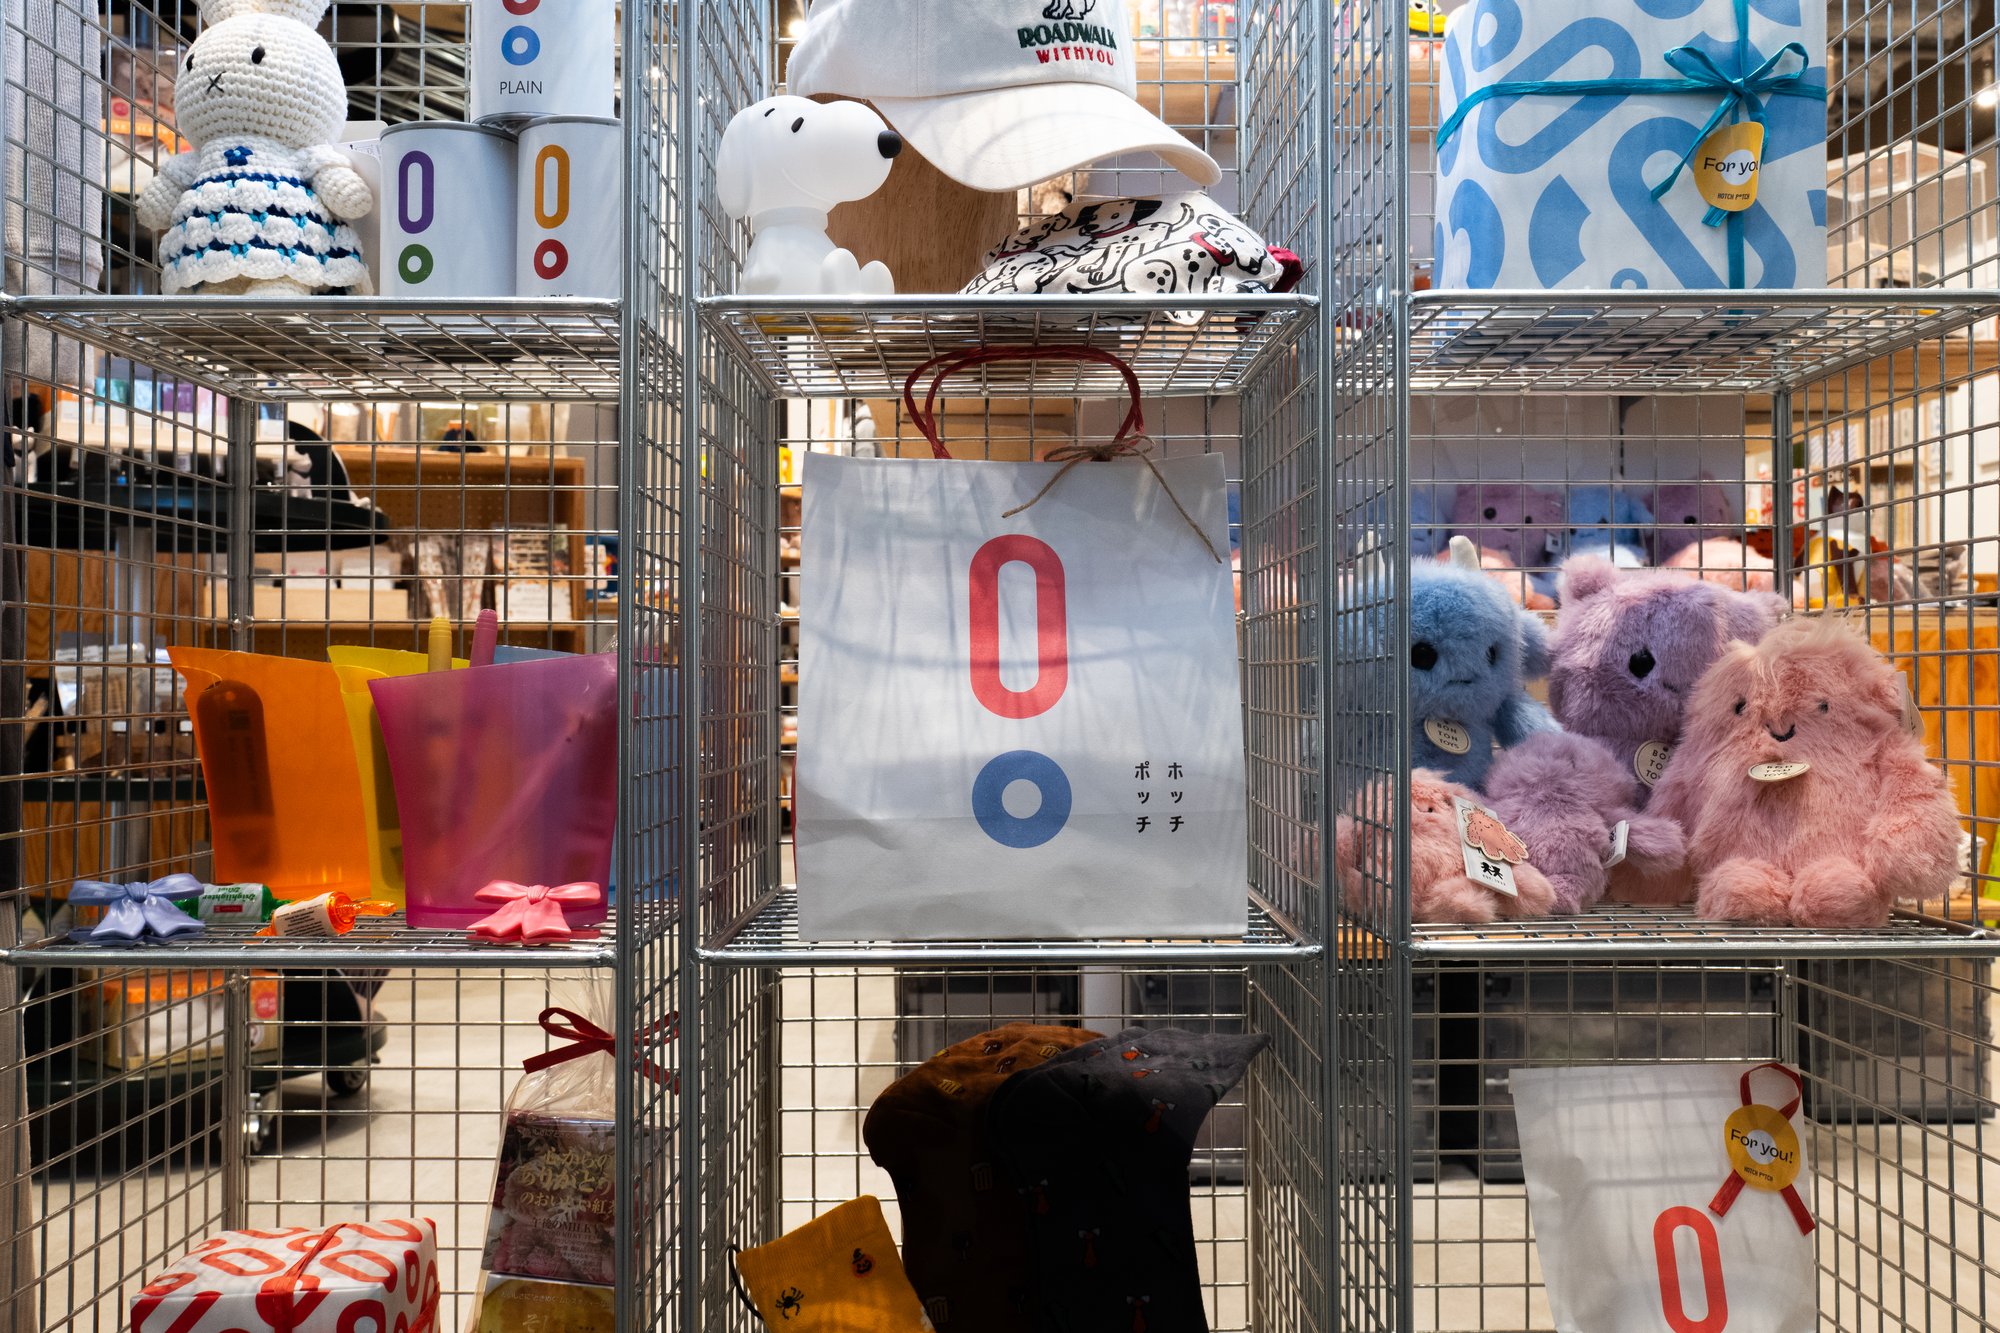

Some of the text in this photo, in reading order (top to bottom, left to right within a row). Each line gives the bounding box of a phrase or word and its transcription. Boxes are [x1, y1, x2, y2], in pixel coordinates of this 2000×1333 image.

[1017, 22, 1117, 50] ROADWALK
[499, 80, 543, 95] PLAIN
[1703, 156, 1736, 172] For
[1436, 721, 1457, 734] BON
[1438, 730, 1459, 742] TON
[1650, 759, 1664, 771] TO
[1134, 760, 1151, 833] ポッチ
[1168, 762, 1184, 833] ホッチ
[1730, 1128, 1793, 1164] For you!
